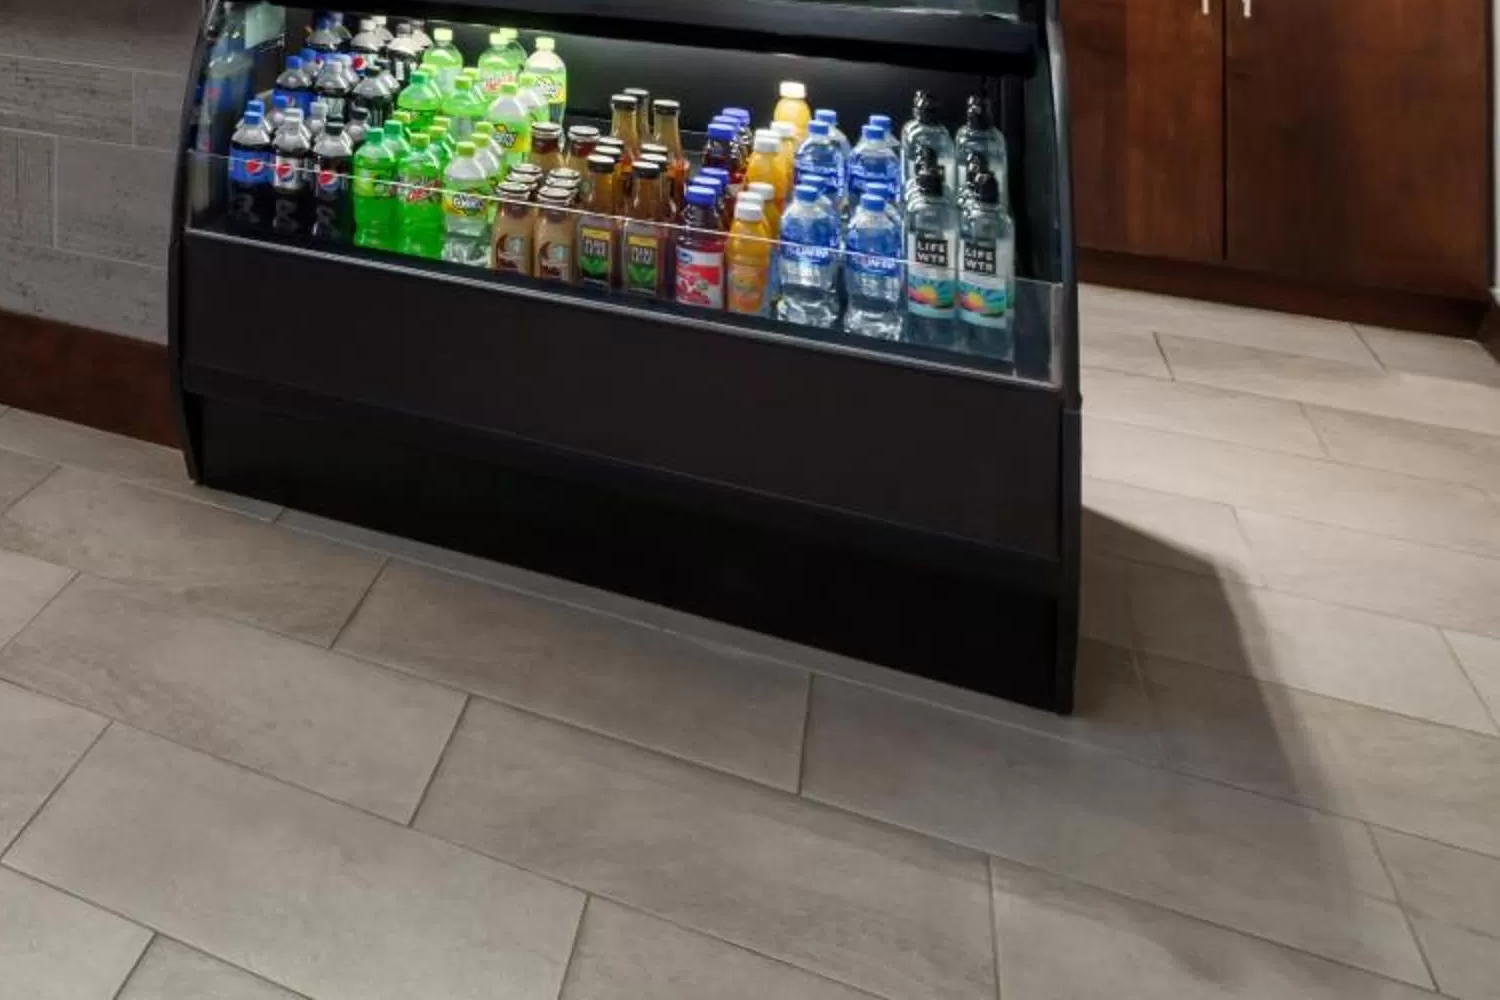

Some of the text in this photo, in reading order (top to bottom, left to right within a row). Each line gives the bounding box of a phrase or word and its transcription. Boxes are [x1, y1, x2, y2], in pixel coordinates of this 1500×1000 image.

[916, 240, 946, 254] LIFE
[916, 251, 946, 265] WTR
[963, 247, 994, 262] LIFE
[964, 259, 994, 272] WTR
